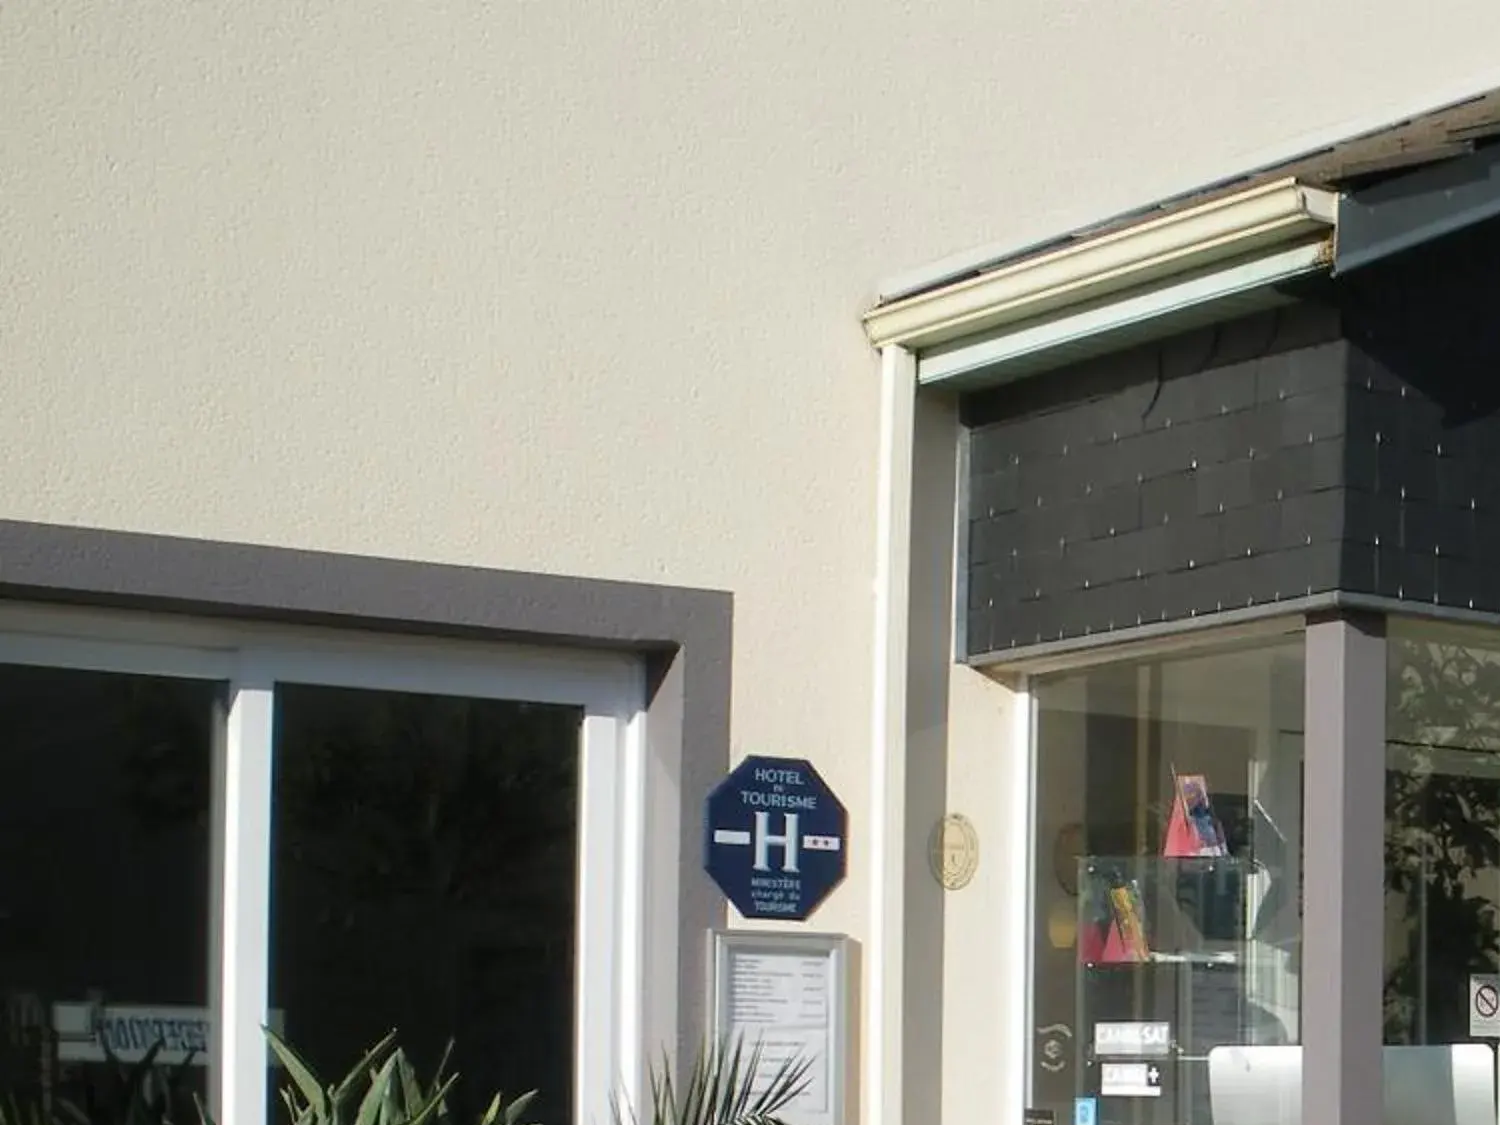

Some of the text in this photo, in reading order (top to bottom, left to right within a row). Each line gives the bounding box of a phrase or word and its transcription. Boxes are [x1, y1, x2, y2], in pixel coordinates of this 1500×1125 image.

[755, 769, 804, 785] HOTEL
[741, 791, 817, 809] TOURISME
[753, 812, 799, 873] H
